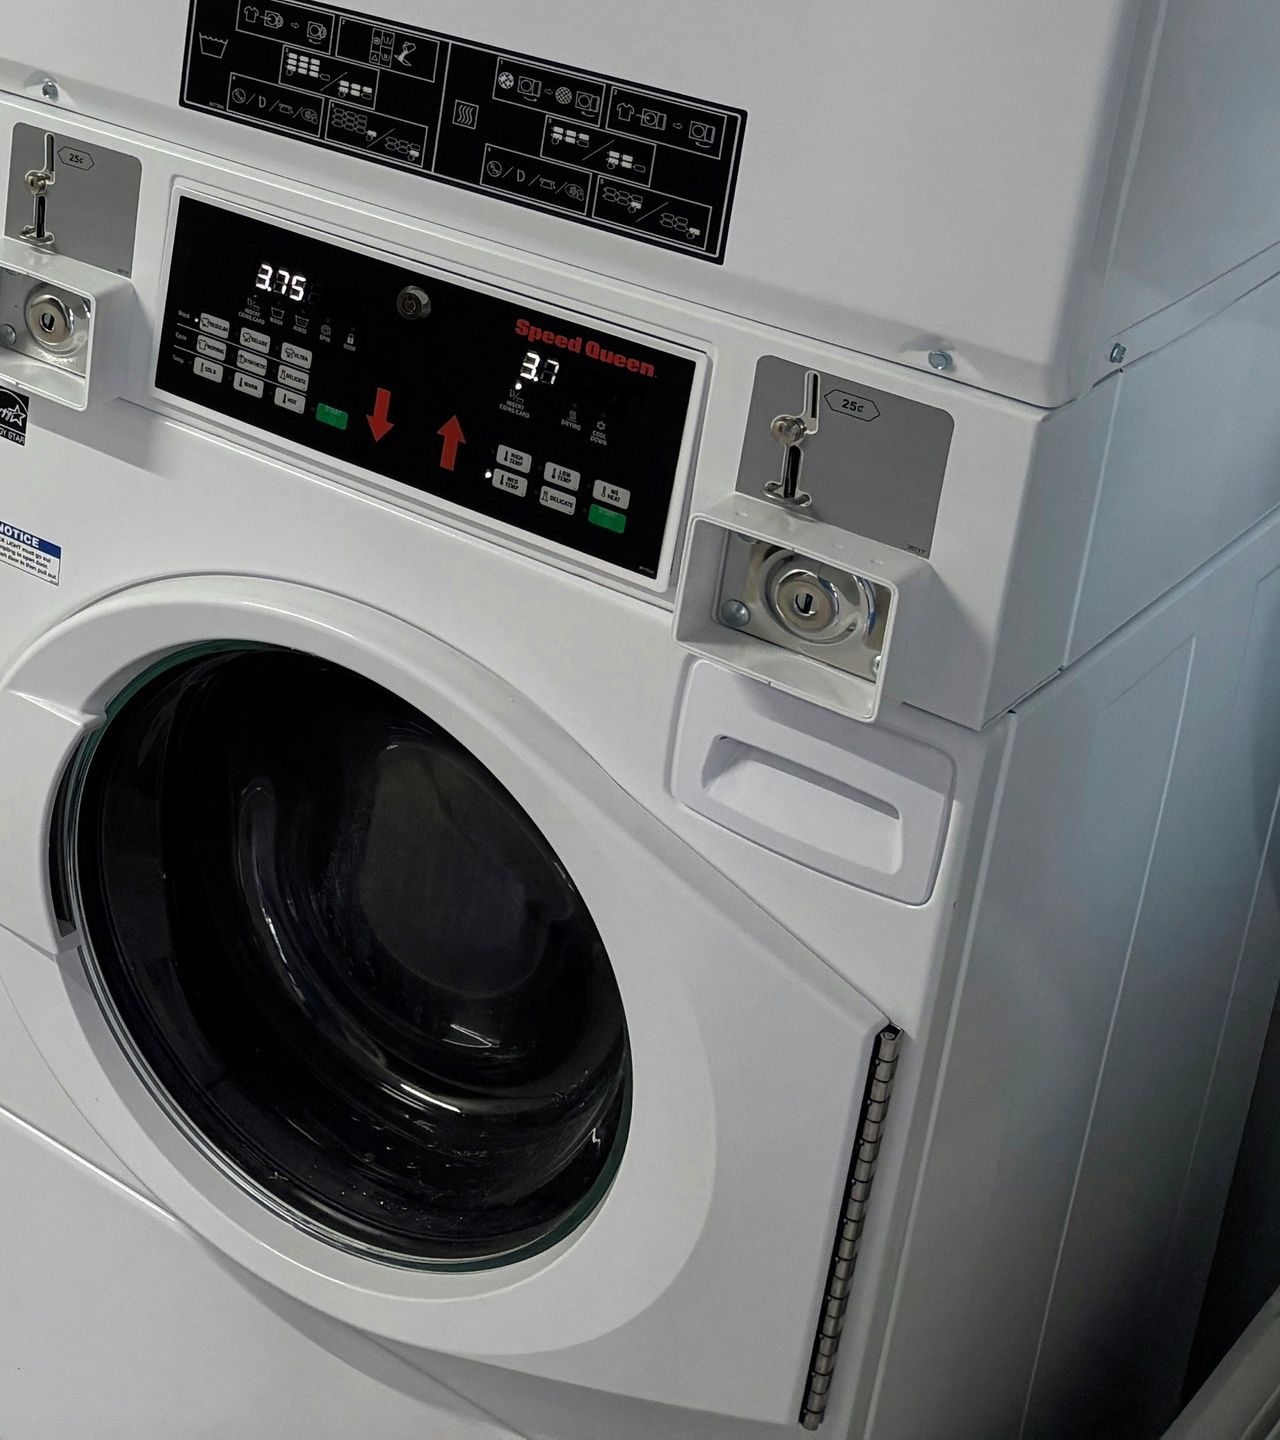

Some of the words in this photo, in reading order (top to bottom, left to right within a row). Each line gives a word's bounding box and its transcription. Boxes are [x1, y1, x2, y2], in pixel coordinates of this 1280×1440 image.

[255, 264, 306, 301] 3.75
[514, 318, 582, 354] Speed
[585, 340, 655, 378] Queen
[520, 351, 560, 385] 3.7
[561, 419, 581, 431] DRYING
[557, 475, 572, 484] TEMP
[559, 470, 571, 478] LOW
[505, 481, 519, 490] TEMP
[549, 495, 574, 509] DELICATE
[607, 494, 621, 503] HEAT
[6, 539, 21, 550] LIGHT
